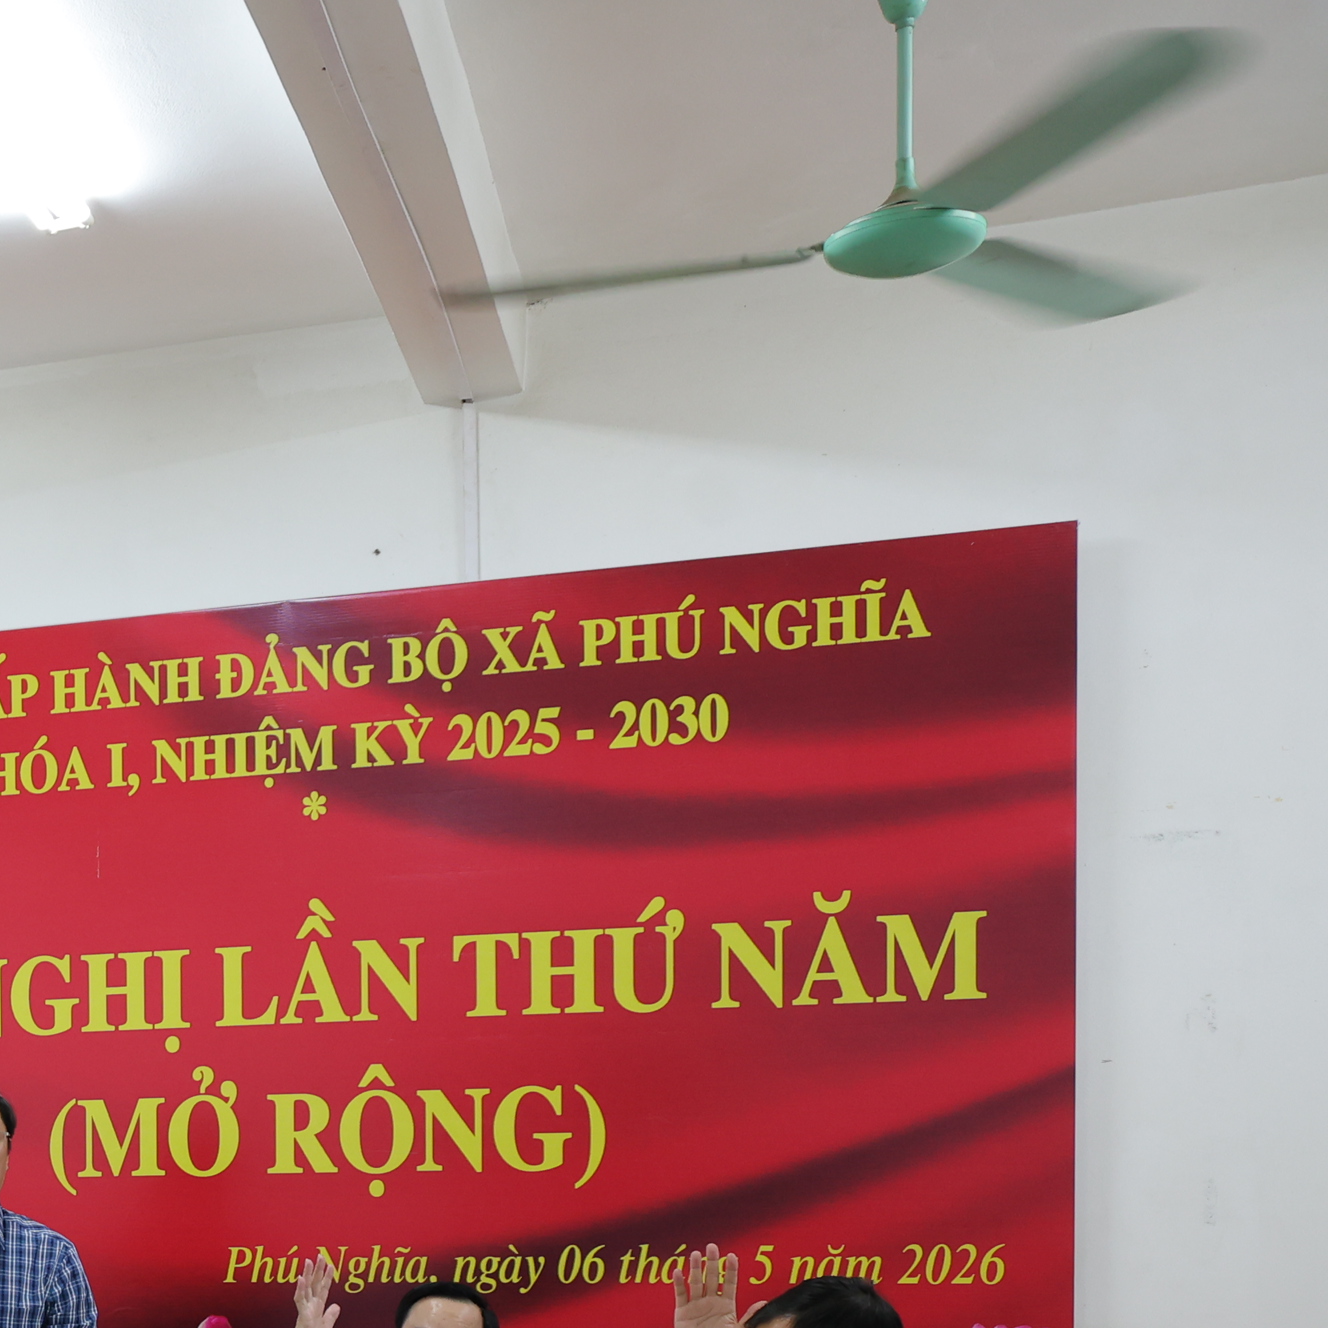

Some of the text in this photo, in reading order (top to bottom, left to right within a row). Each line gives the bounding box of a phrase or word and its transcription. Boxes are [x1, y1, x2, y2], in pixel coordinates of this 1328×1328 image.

[49, 651, 205, 714] HÀNH
[215, 633, 375, 699] ĐẢNG
[387, 617, 469, 692] BỘ
[481, 609, 566, 675] XÃ
[579, 593, 706, 667] PHÚ
[719, 578, 932, 655] NGHĨA
[106, 742, 141, 796] I,
[151, 715, 339, 788] NHIỆM
[350, 703, 434, 769] KỲ
[447, 706, 561, 761] 2025
[576, 728, 595, 741] -
[609, 693, 730, 750] 2030
[215, 897, 426, 1027] LẦN
[452, 896, 685, 1018] THỨ
[711, 889, 988, 1009] NĂM
[49, 1063, 606, 1198] (MỞ RỘNG)
[222, 1244, 300, 1284] Phú
[452, 1245, 547, 1294] ngày
[557, 1244, 606, 1284] 06
[748, 1244, 775, 1285] 5
[788, 1244, 883, 1285] năm
[896, 1243, 1006, 1285] 2026
